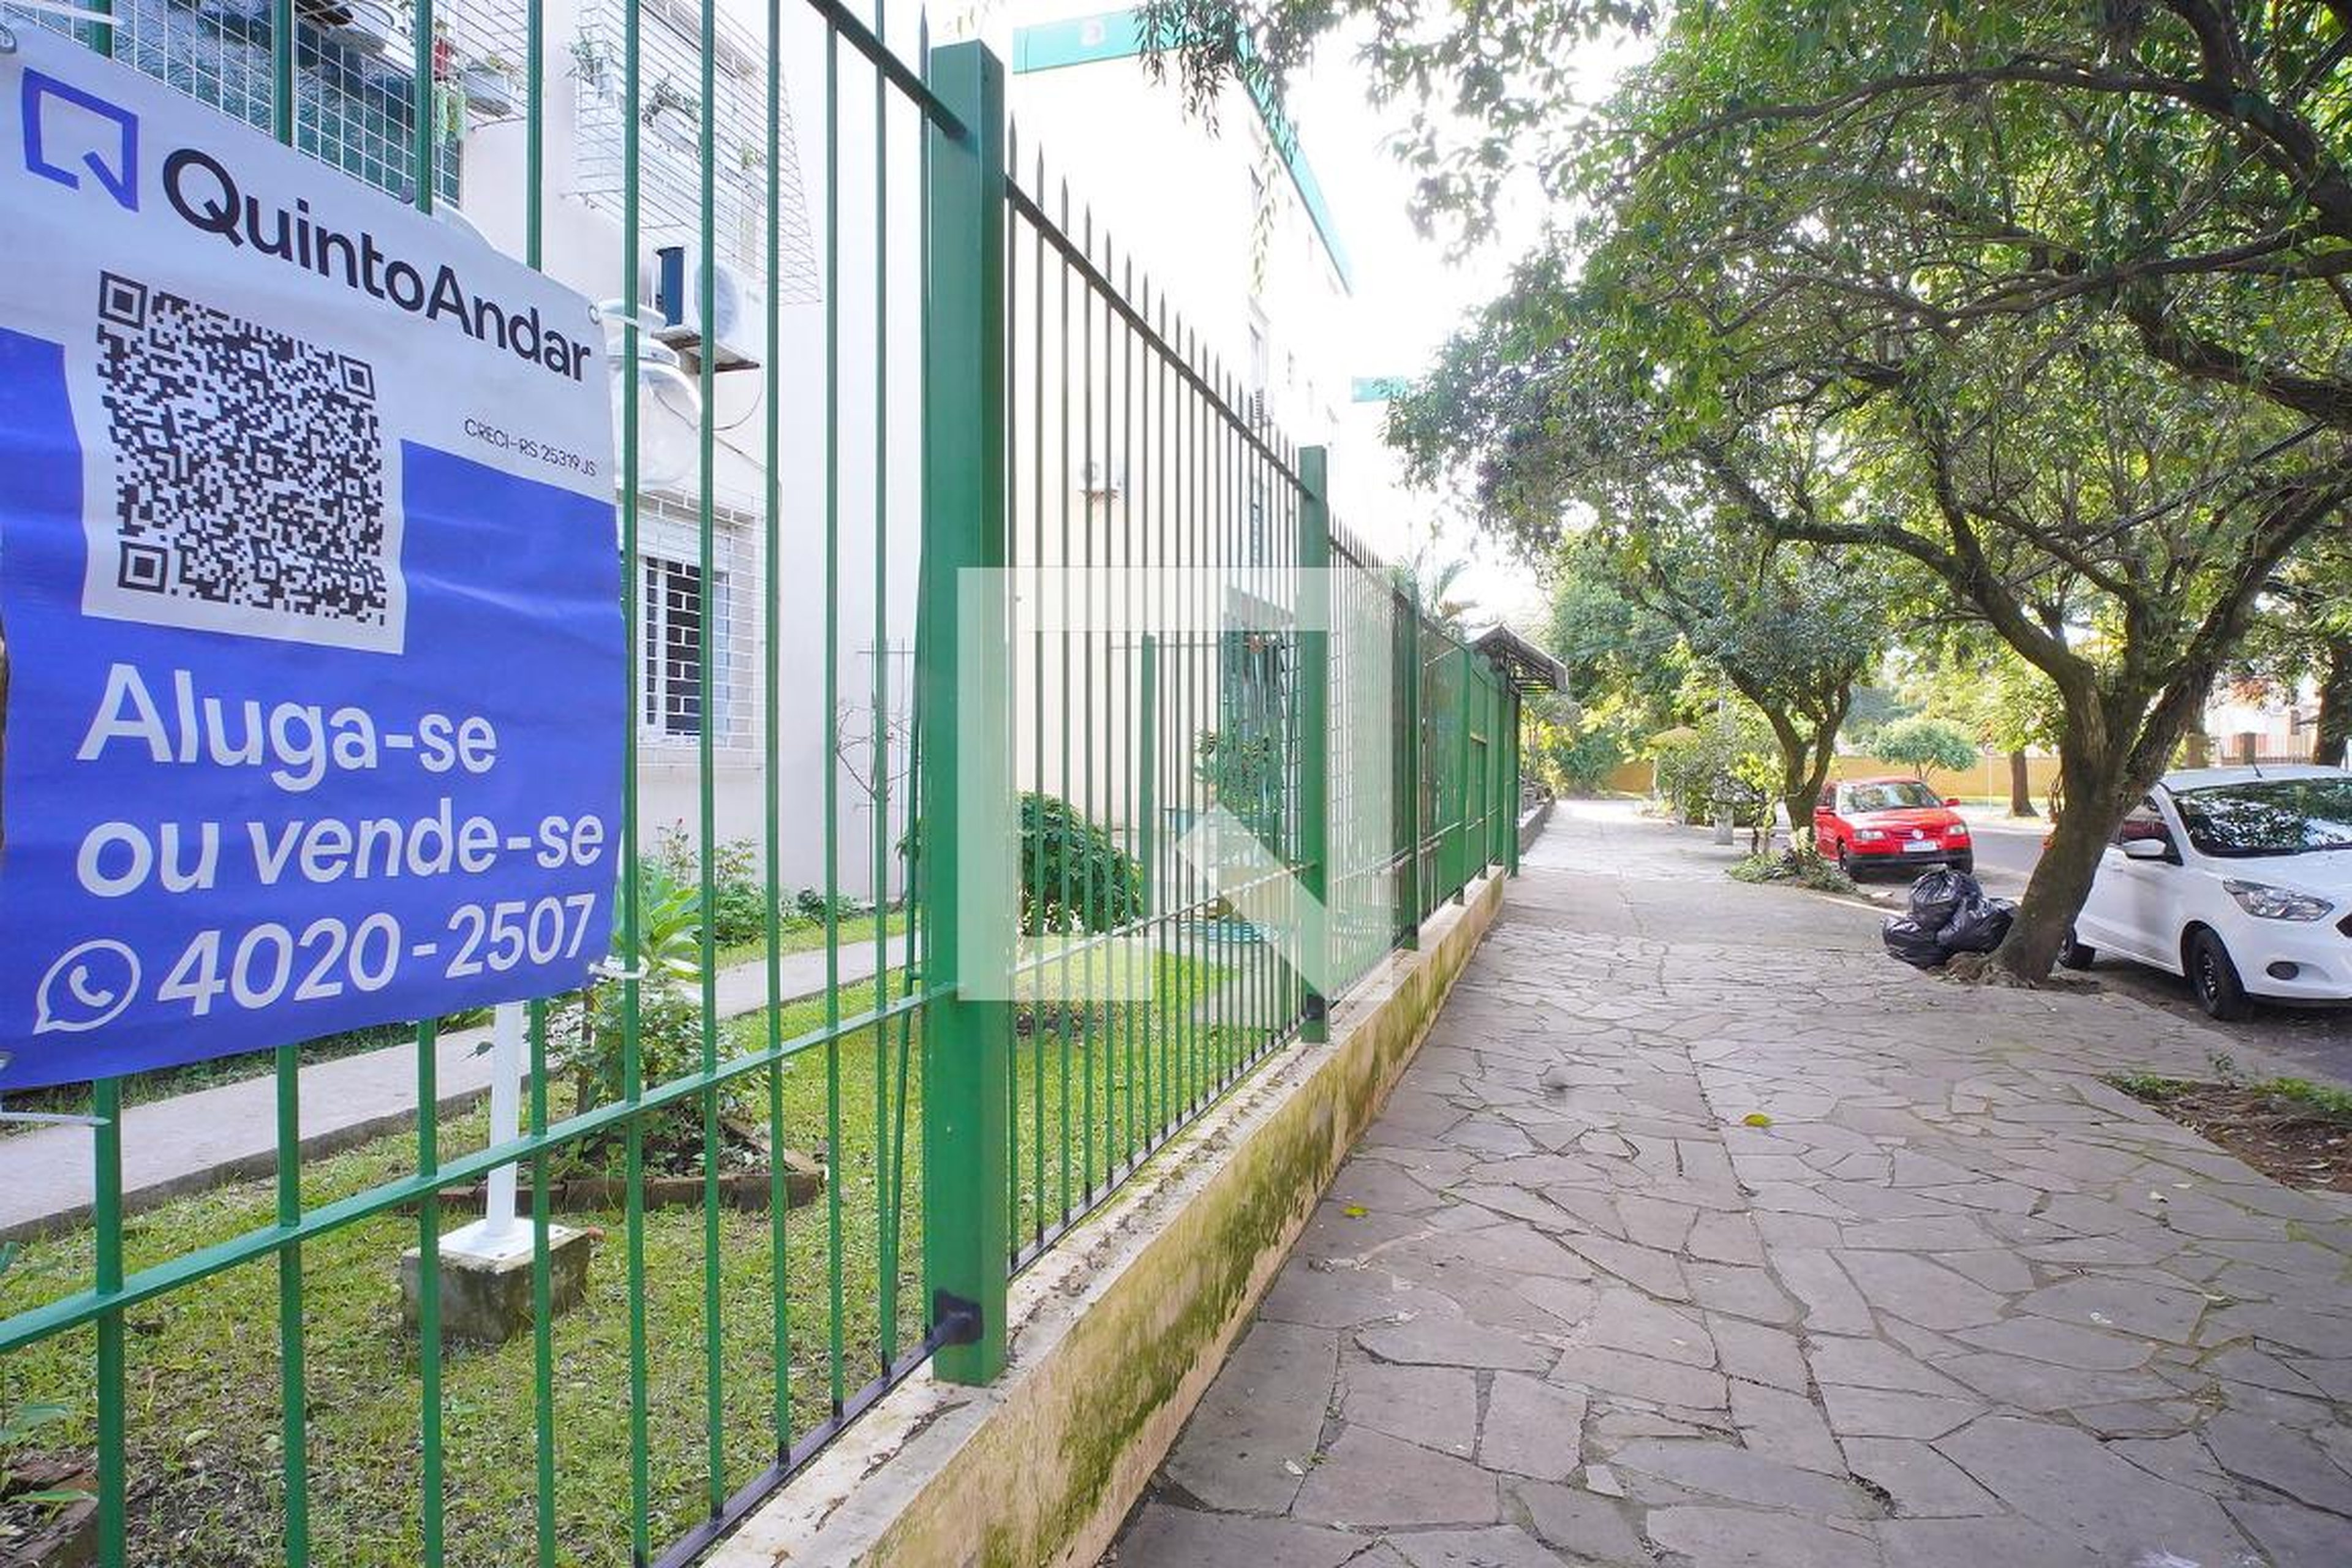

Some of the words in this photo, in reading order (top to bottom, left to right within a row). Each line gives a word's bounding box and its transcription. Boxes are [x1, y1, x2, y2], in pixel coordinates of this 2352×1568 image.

[162, 148, 591, 382] QuintoAndar
[464, 418, 538, 458] CRECI-RS
[581, 460, 597, 477] JS
[76, 663, 497, 792] Aluga-se
[77, 822, 219, 897] ou
[247, 797, 603, 884] vende-se
[157, 893, 596, 1016] 4020-2507
